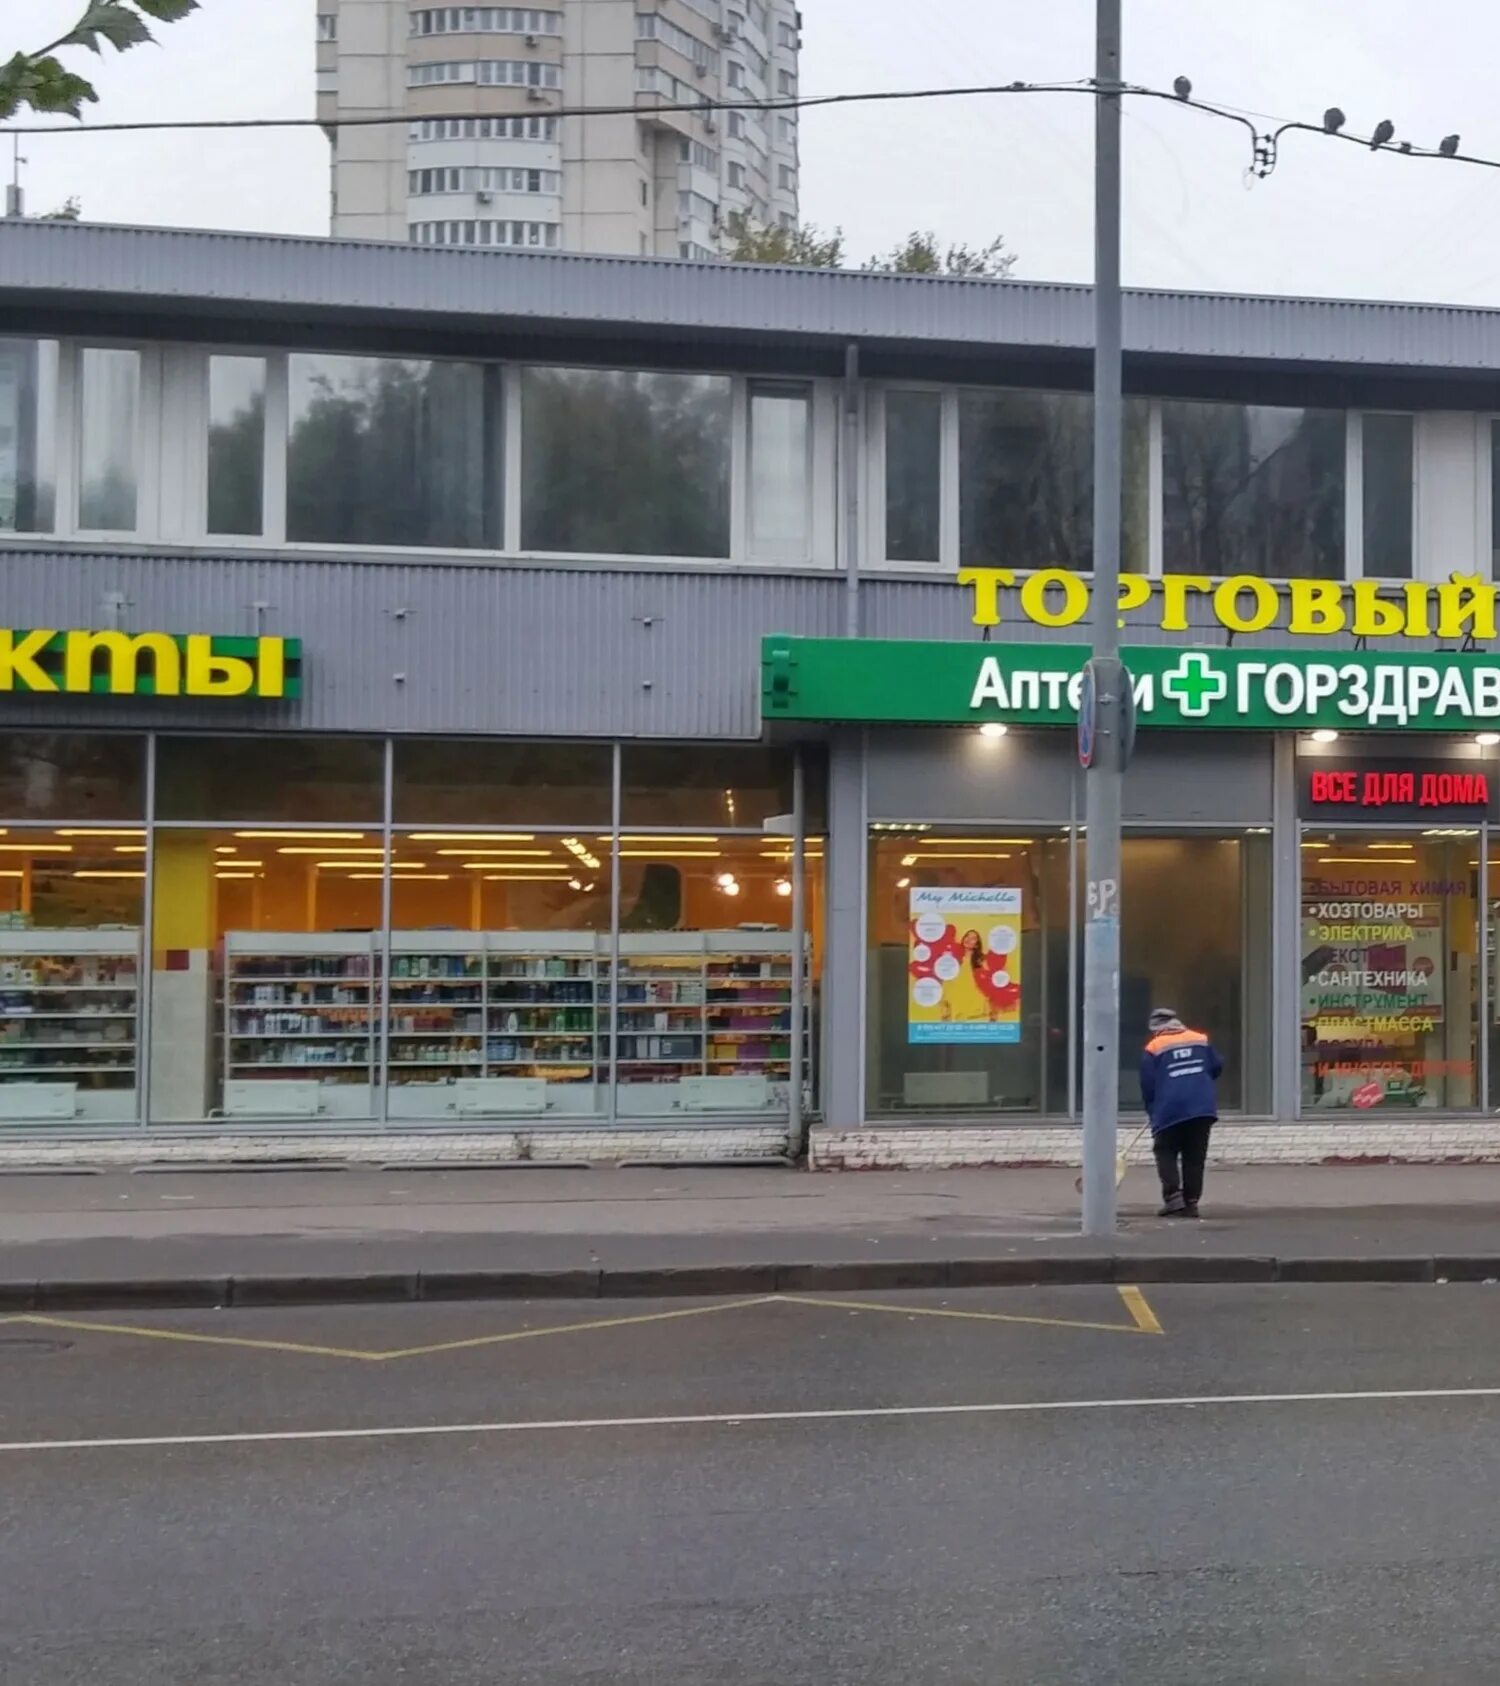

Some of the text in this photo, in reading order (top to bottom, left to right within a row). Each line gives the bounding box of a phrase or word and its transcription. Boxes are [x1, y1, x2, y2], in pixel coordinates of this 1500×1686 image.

[970, 657, 1154, 712] Аптеи
[1311, 771, 1489, 807] ВСЕ ДЛЯ ДОМА
[1318, 903, 1423, 919] ХОЗТОВАРЫ
[1319, 924, 1415, 941] ЭЛЕКТРИКА
[1317, 970, 1428, 987] САНТЕХНИКА
[1318, 994, 1428, 1009] ИНСТРУМЕНТ
[1318, 1015, 1435, 1032] ПЛАСТМАССА
